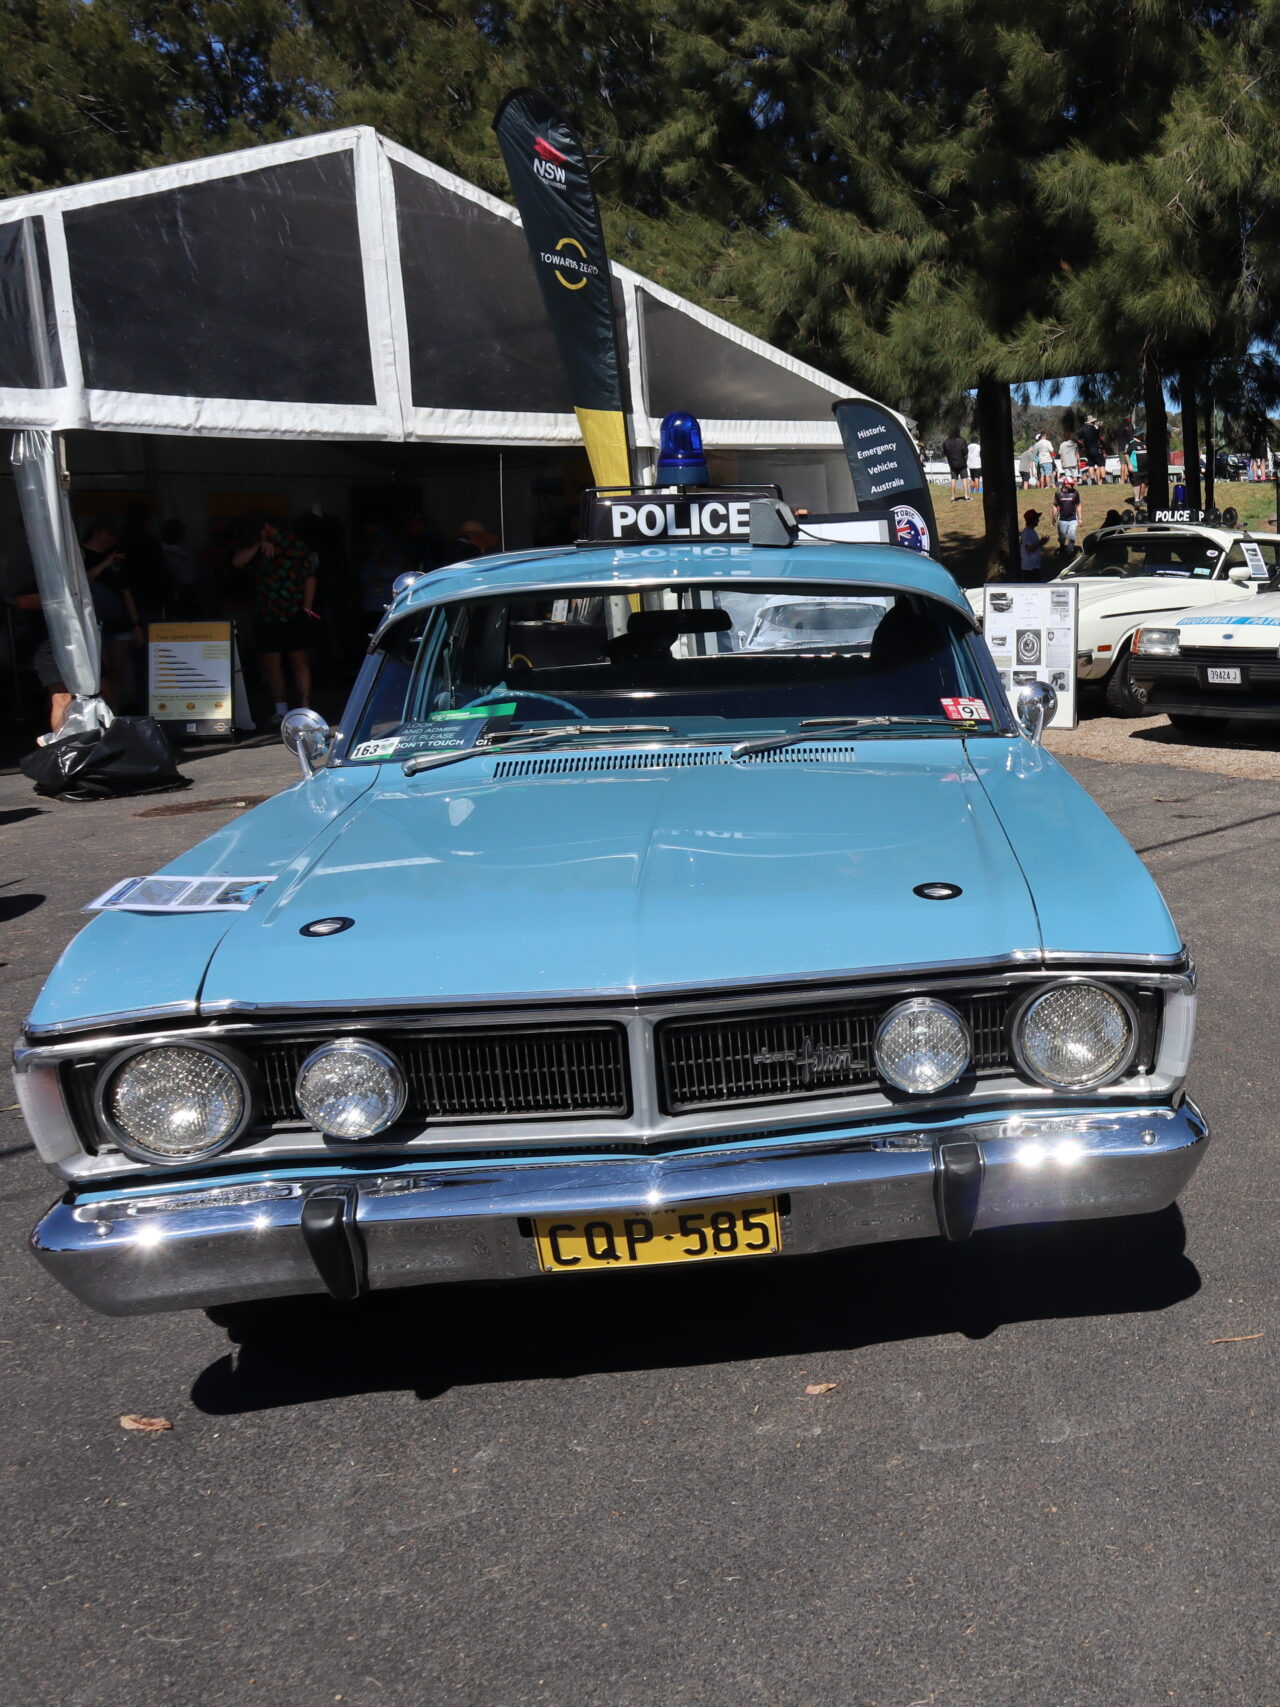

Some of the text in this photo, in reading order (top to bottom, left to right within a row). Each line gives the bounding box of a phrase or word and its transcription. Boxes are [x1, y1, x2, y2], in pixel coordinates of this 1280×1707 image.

[533, 158, 566, 184] NSW
[540, 252, 599, 275] TOWARDS ZERO
[857, 425, 886, 440] Historic
[857, 442, 897, 459] Emergency
[868, 461, 898, 476] Vehicles
[870, 478, 905, 494] Australia
[611, 502, 750, 538] POLICE
[895, 511, 915, 520] TORIC
[1155, 510, 1190, 522] POLICE
[1179, 616, 1235, 626] HIGHWAY
[1211, 670, 1237, 680] 39424 J
[962, 706, 974, 717] 9
[426, 725, 463, 733] ADMIRE
[419, 732, 455, 740] PLEASE
[428, 738, 465, 747] TOUCH
[355, 744, 379, 757] 163
[548, 1208, 770, 1265] CQP 585
